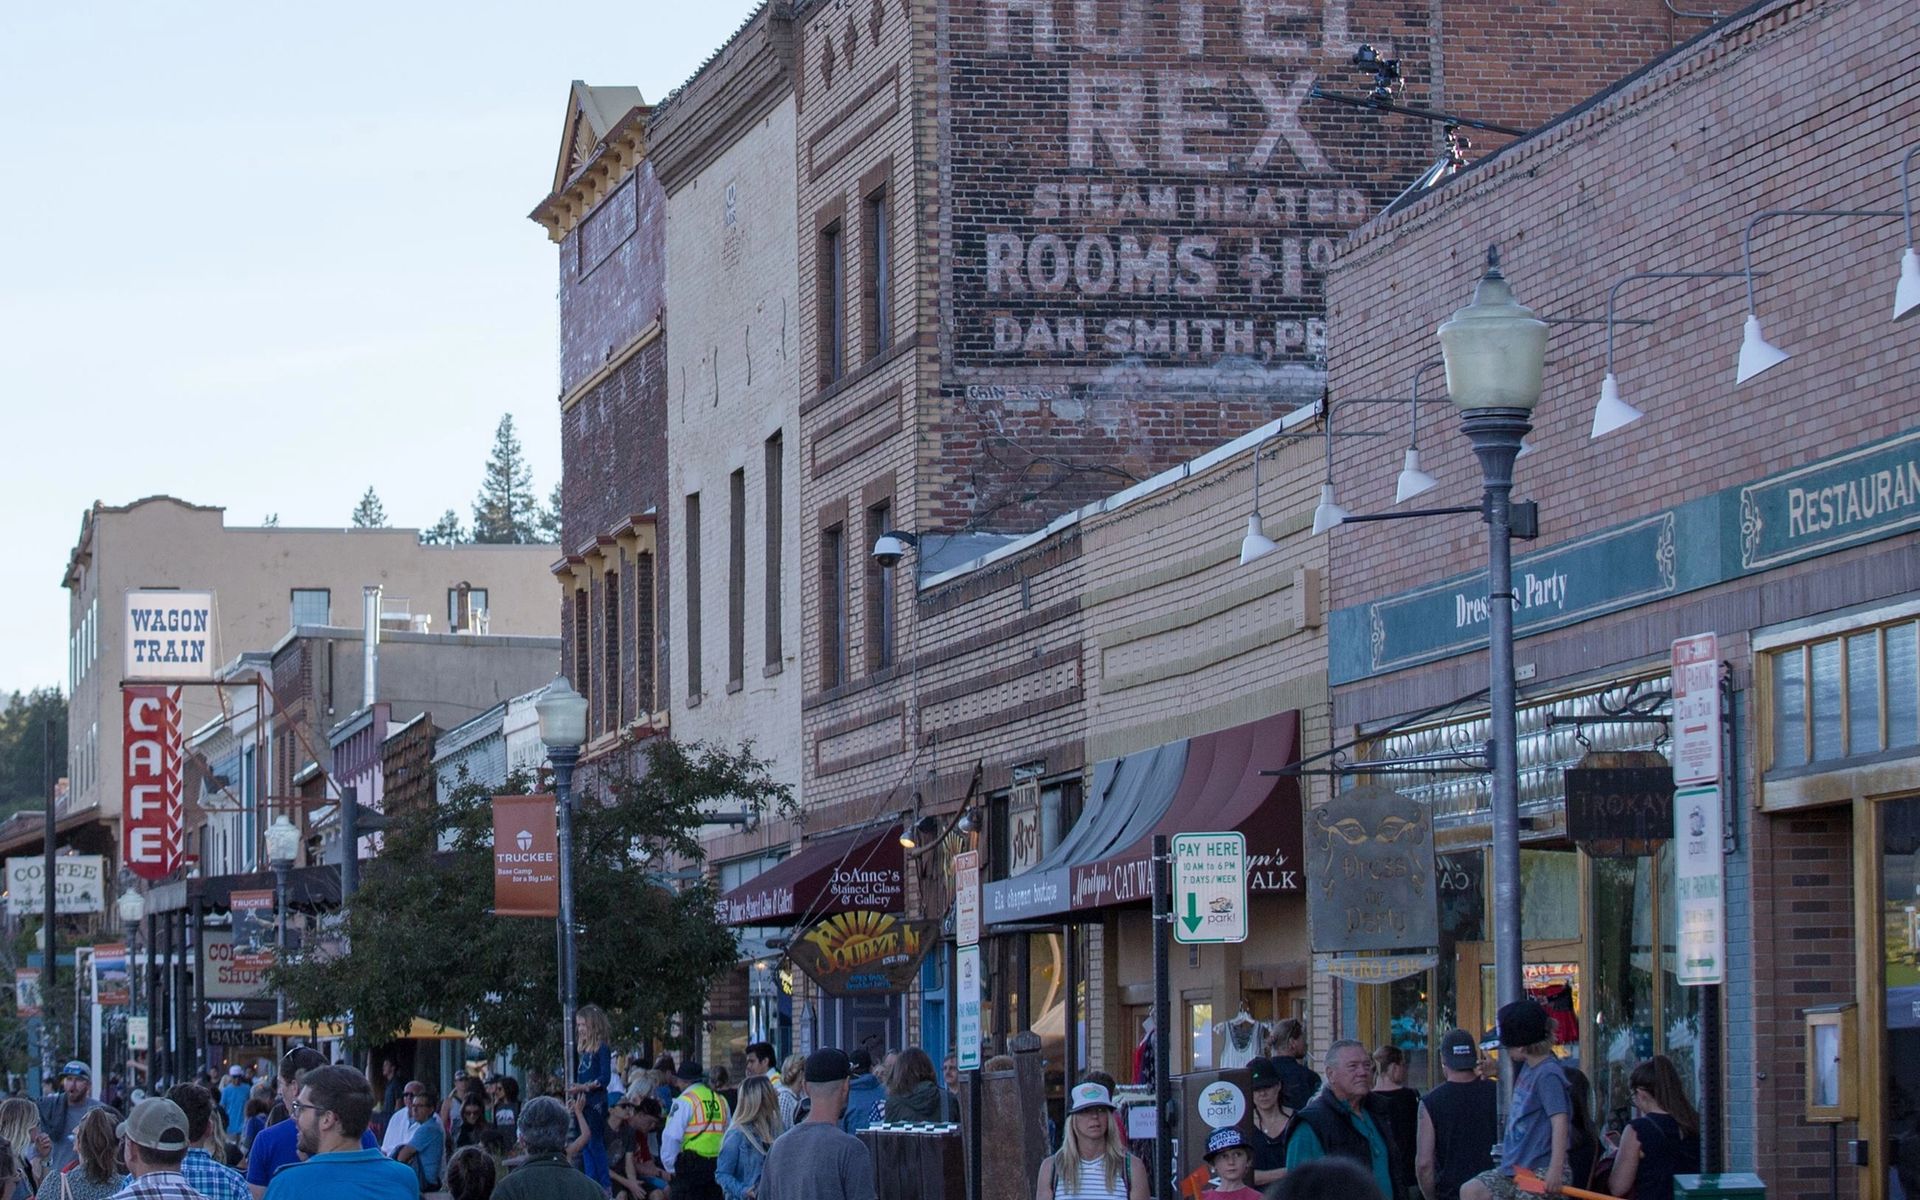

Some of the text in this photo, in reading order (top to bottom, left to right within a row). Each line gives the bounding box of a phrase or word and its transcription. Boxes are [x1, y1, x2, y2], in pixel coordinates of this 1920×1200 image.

[1068, 68, 1335, 172] REX
[1033, 183, 1368, 223] STEAM HEATED
[985, 233, 1219, 297] ROOMS
[993, 317, 1086, 353] DAN
[1524, 567, 1568, 610] Party
[130, 608, 209, 632] WAGON
[134, 639, 206, 663] TRAIN
[128, 697, 163, 863] CAFE
[1577, 791, 1671, 819] TROKAY
[497, 852, 553, 863] TRUCKEE
[1179, 842, 1239, 856] PAY HERE
[1183, 863, 1191, 871] 10
[1192, 862, 1203, 870] AM
[1207, 862, 1214, 870] to
[1224, 861, 1235, 869] PM
[1246, 848, 1289, 871] yn's
[1343, 856, 1407, 880] Dress
[15, 863, 97, 881] COFEE
[513, 868, 532, 876] Camp
[528, 875, 538, 883] Big
[831, 867, 900, 882] JoAnne's
[1183, 876, 1188, 884] 7
[1246, 871, 1297, 889] ALK
[830, 883, 900, 894] Stained Glass
[1033, 880, 1057, 905] boutique
[1072, 862, 1112, 907] Marilyn's
[233, 898, 271, 907] TRUCKEE
[841, 893, 890, 907] & Gallery
[1207, 913, 1236, 924] park!
[1207, 1105, 1236, 1117] park!
